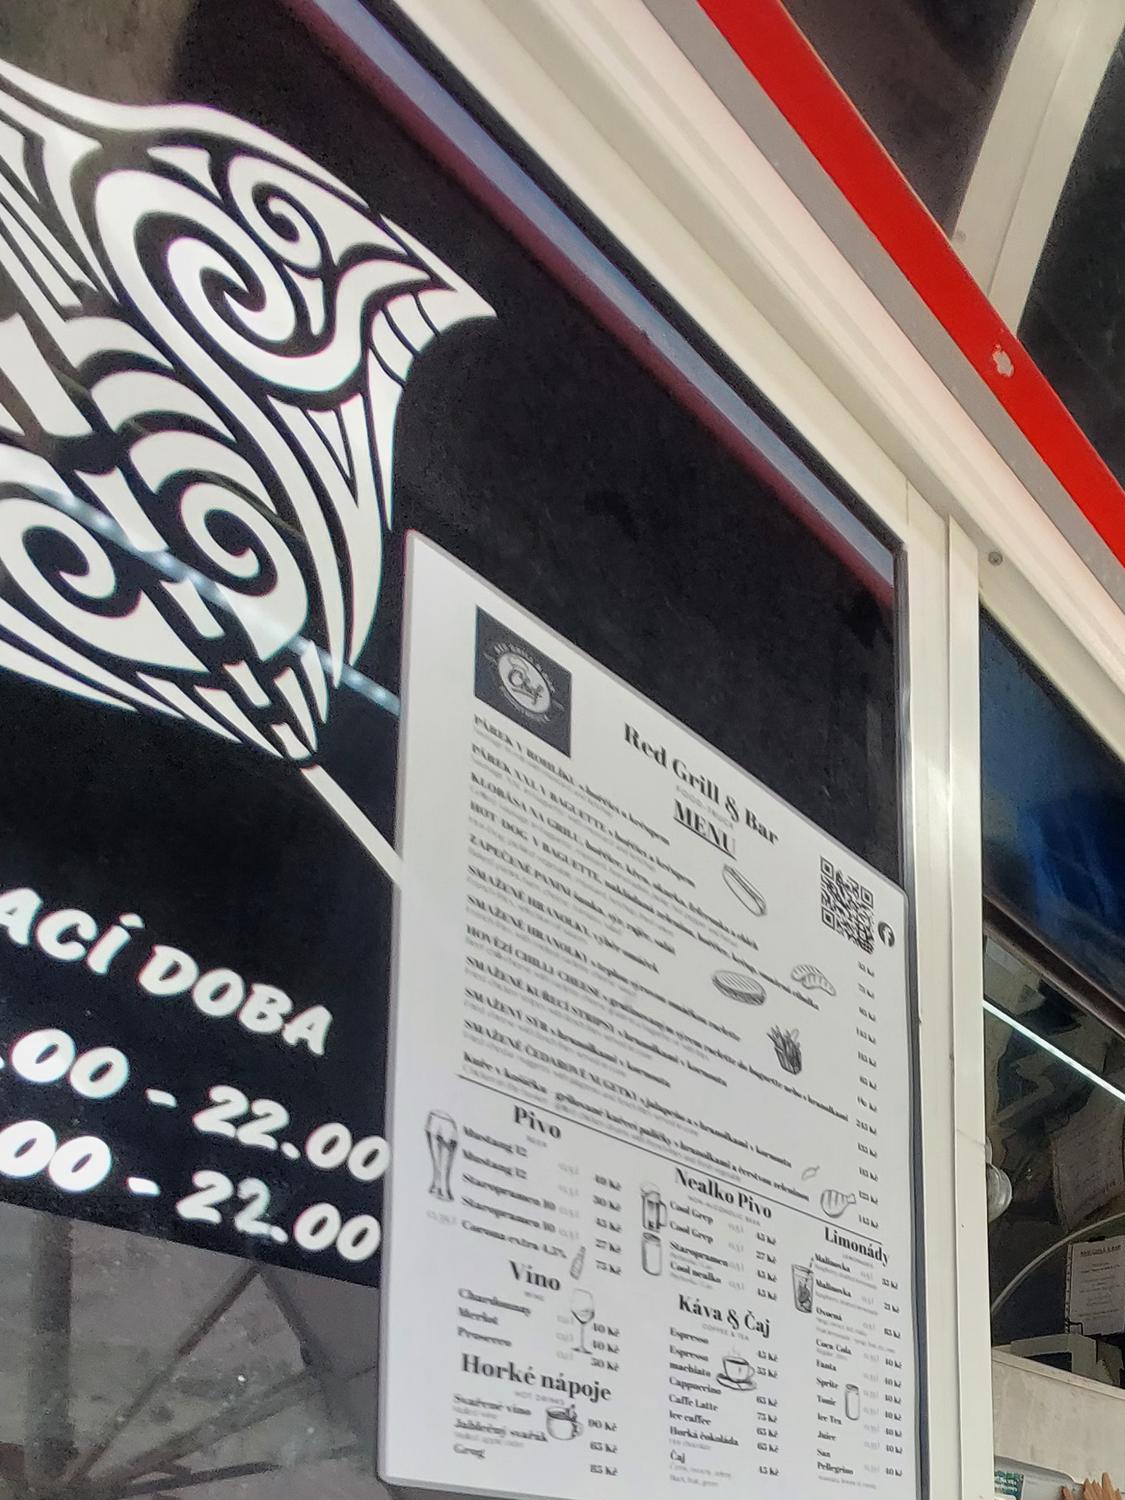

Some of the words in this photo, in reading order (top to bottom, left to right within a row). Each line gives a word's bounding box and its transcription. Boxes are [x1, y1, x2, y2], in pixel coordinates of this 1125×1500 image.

[624, 721, 665, 768] Red
[673, 755, 718, 805] Grill
[725, 792, 739, 824] &
[745, 807, 778, 847] Bar
[675, 799, 735, 856] MENU
[138, 944, 333, 1055] DOBA
[192, 1084, 392, 1181] 22.00
[513, 1105, 561, 1140] Pivo
[175, 1169, 381, 1261] 22.00
[676, 1167, 733, 1204] Nealko
[738, 1191, 771, 1219] Pivo
[825, 1226, 887, 1267] Limonády
[509, 1259, 560, 1291] Víno
[679, 1293, 722, 1321] Káva
[727, 1308, 739, 1329] &
[744, 1309, 769, 1338] Čaj
[461, 1351, 535, 1385] Horké
[540, 1368, 611, 1405] nápoje
[670, 1450, 685, 1463] Čaj
